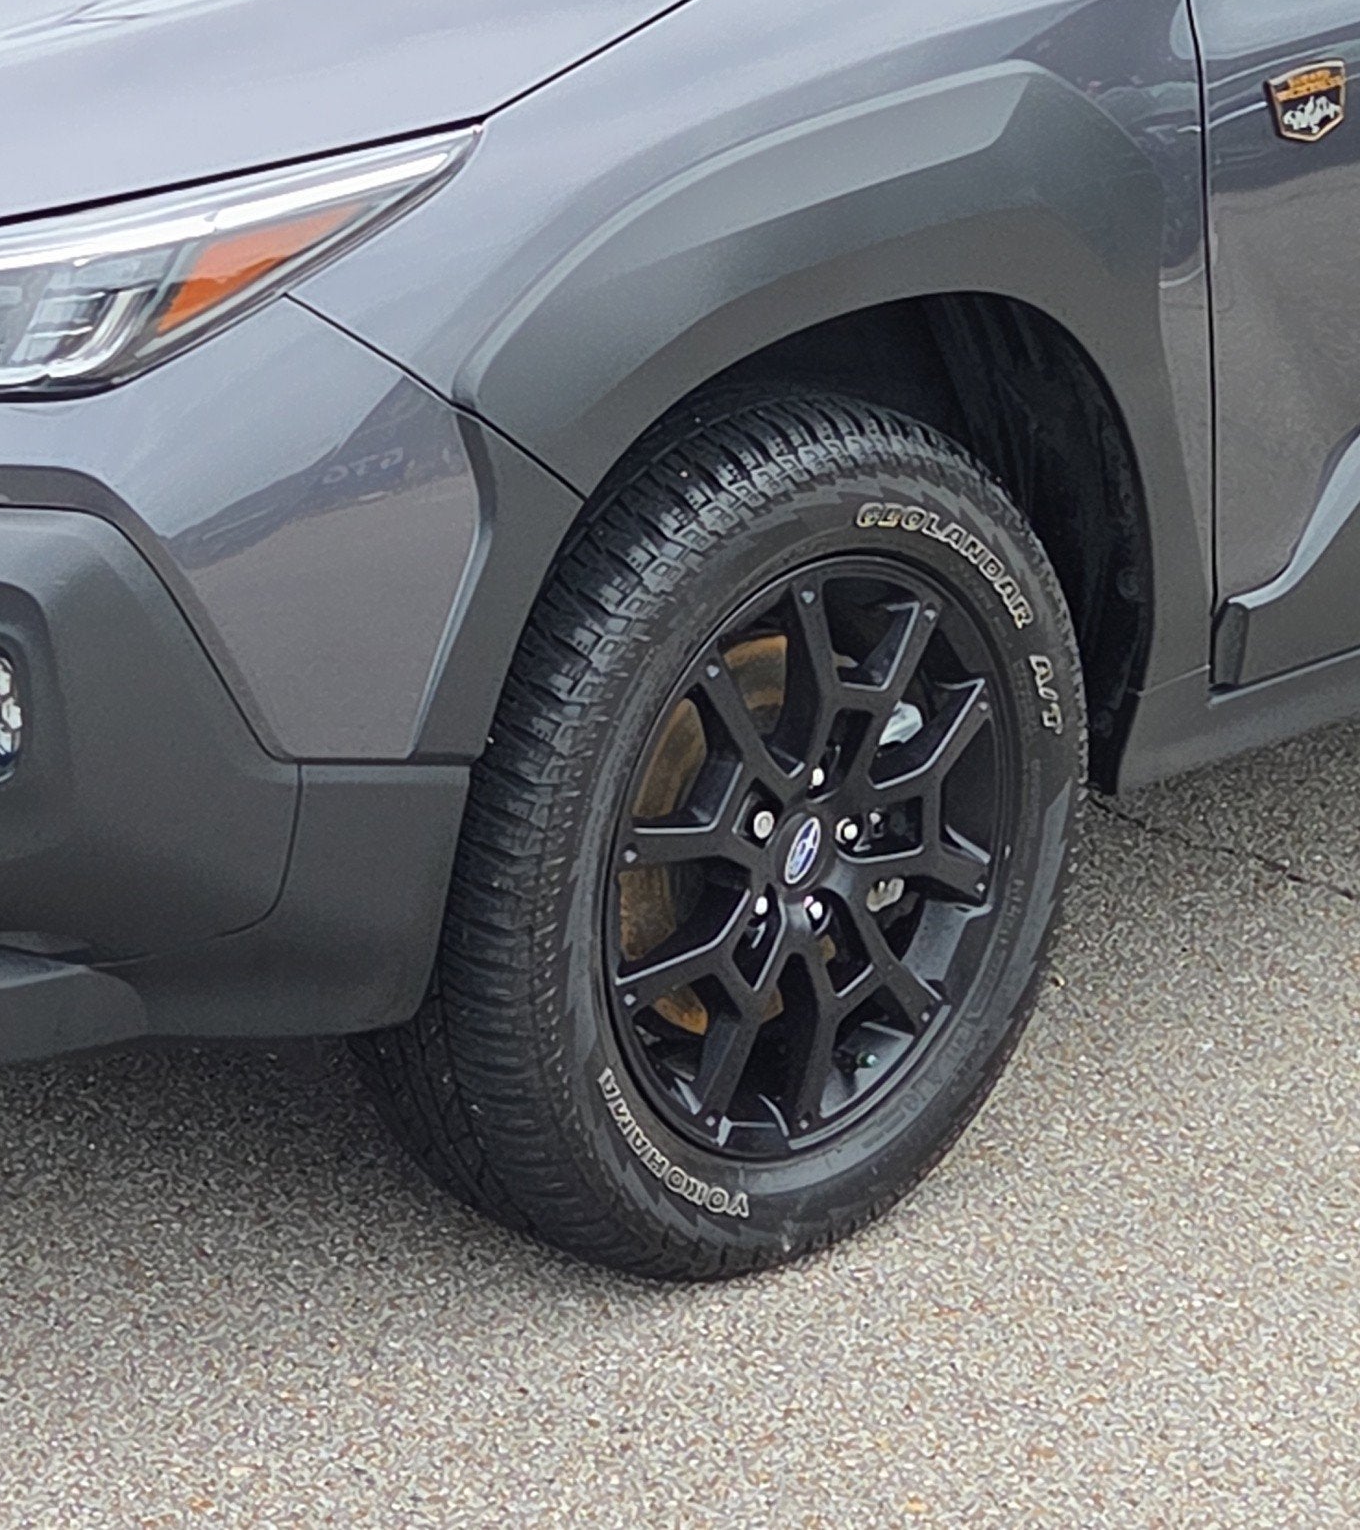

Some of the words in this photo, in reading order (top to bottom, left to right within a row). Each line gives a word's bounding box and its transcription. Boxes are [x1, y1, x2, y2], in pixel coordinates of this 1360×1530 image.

[855, 501, 1034, 630] GEOLANDAR
[1029, 654, 1064, 734] A/T
[596, 1067, 750, 1219] YOKOHAMA
